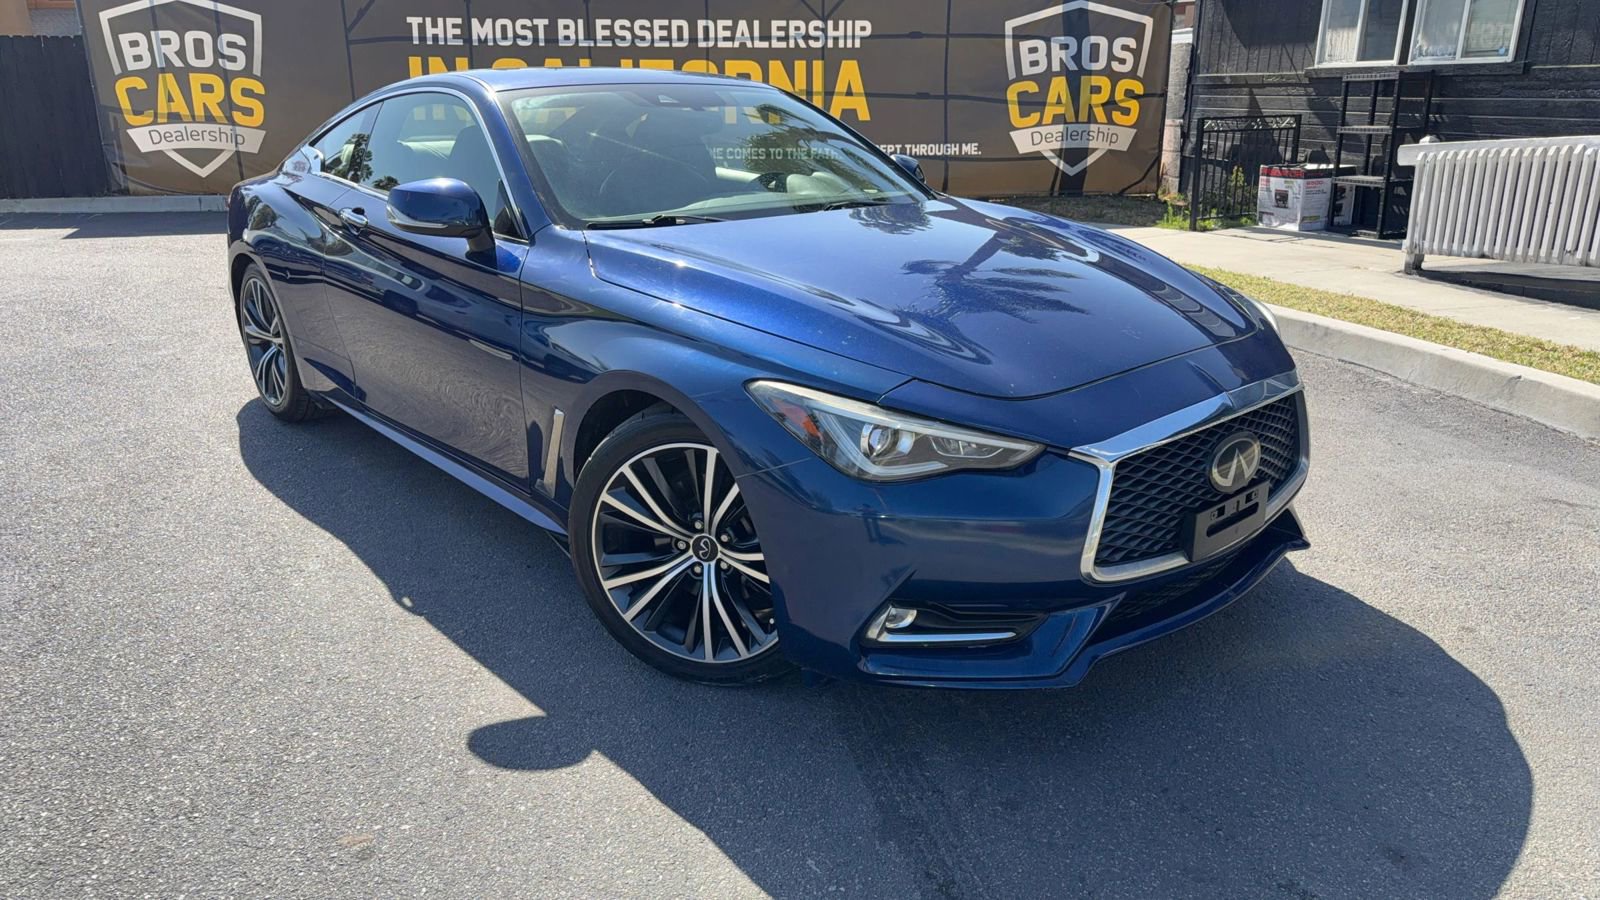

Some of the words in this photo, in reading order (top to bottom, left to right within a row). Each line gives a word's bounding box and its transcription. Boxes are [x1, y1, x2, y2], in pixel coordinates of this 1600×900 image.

[118, 30, 247, 71] BROS
[406, 16, 463, 45] THE
[471, 18, 549, 46] MOST
[557, 18, 689, 48] BLESSED
[697, 19, 872, 49] DEALERSHIP
[1018, 35, 1137, 76] BROS
[114, 73, 266, 127] CARS
[1006, 75, 1145, 128] CARS
[148, 125, 246, 147] Dealership
[727, 147, 766, 160] COMES
[769, 147, 783, 160] TO
[786, 147, 808, 160] THE
[905, 143, 959, 156] THROUGH
[962, 142, 982, 155] ME.
[1030, 126, 1119, 147] Dealership
